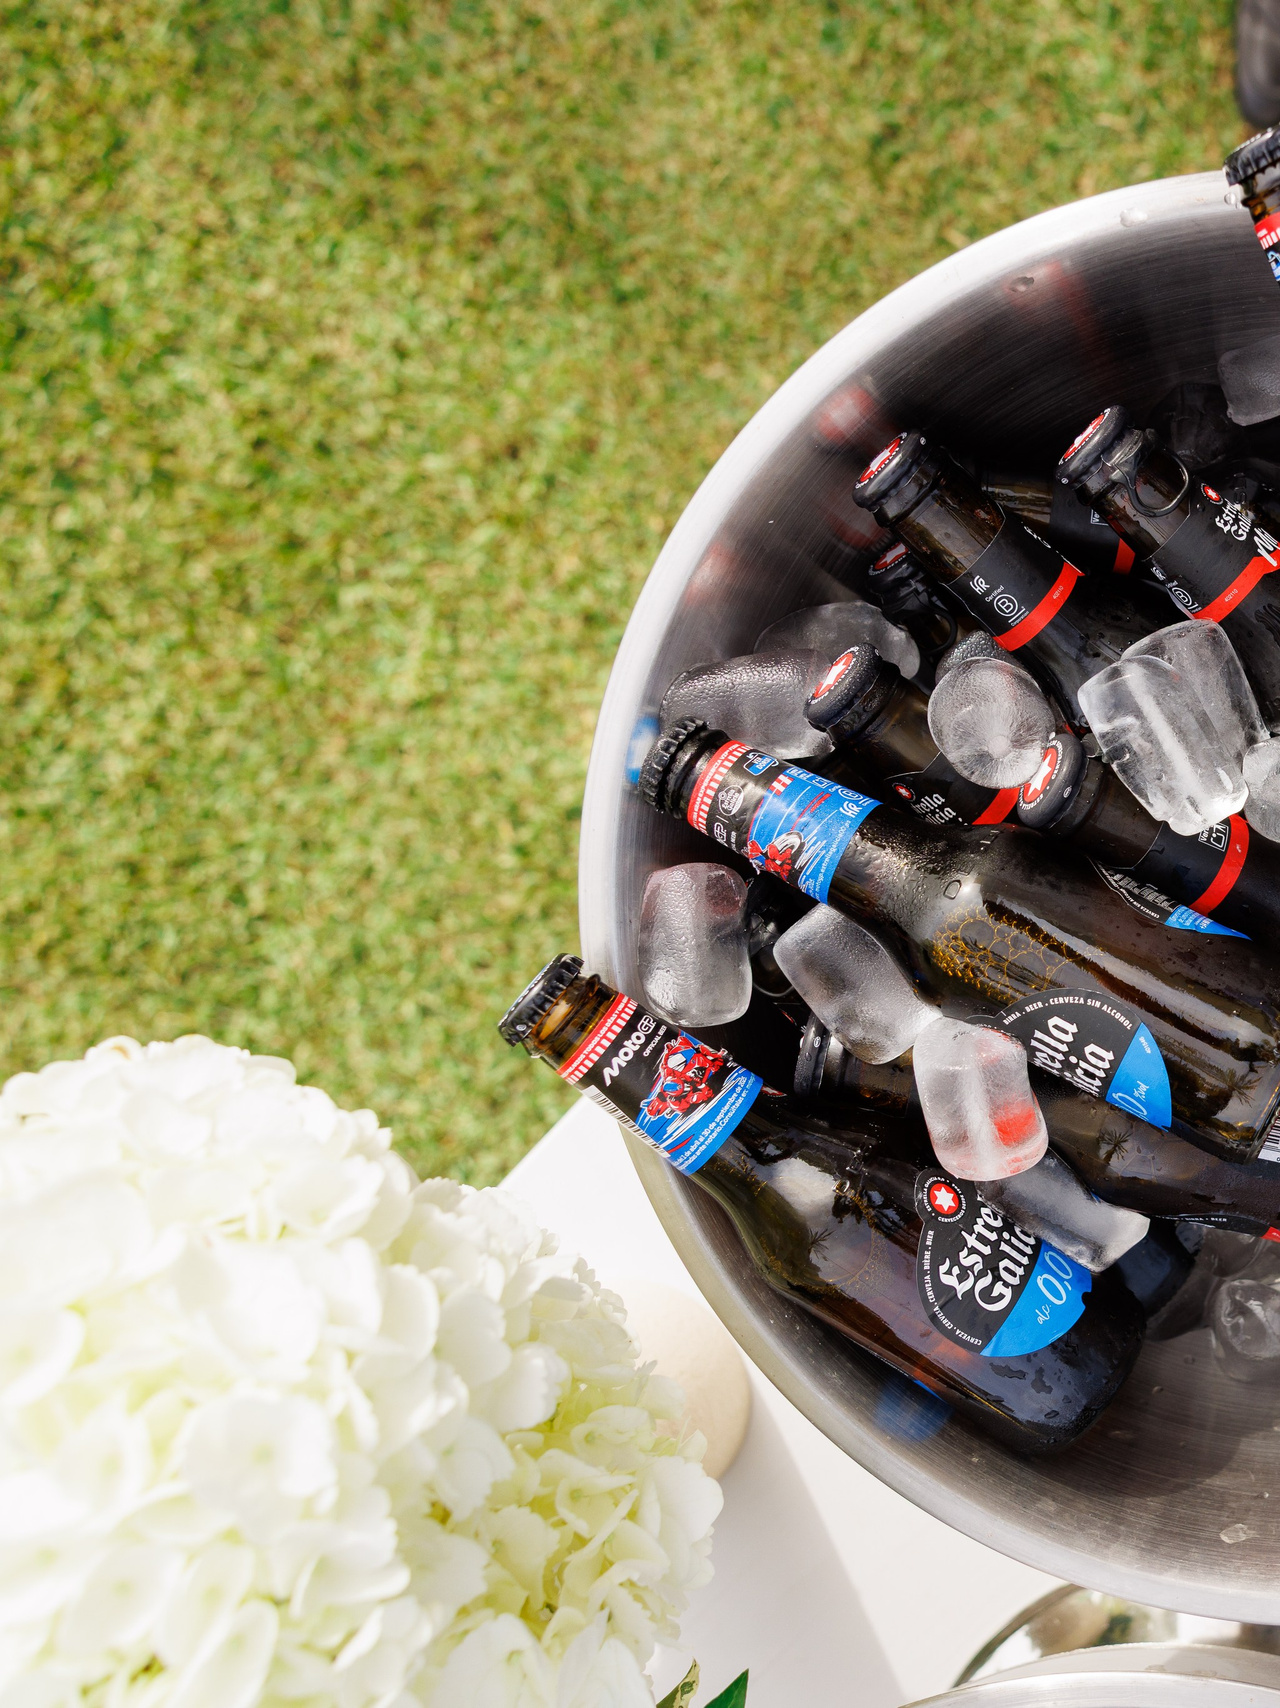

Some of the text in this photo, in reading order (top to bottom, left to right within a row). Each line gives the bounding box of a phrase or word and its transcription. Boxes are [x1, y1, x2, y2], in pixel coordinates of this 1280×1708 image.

[984, 584, 1004, 603] Certified
[1224, 588, 1238, 602] 402110
[838, 798, 862, 819] HR
[1003, 1011, 1020, 1024] BIRRA
[1025, 1003, 1043, 1011] BEER
[1087, 999, 1098, 1009] SIN
[1102, 1003, 1133, 1029] ALCOHOL
[582, 1035, 600, 1055] TODOS
[596, 1024, 608, 1037] LOS
[603, 1011, 618, 1027] DÍAS
[641, 1024, 667, 1057] OFFICIAL BEER
[595, 1014, 657, 1087] MotoGP
[686, 1138, 700, 1152] abril
[712, 1091, 737, 1124] septiembre
[693, 1142, 706, 1155] ante
[702, 1122, 722, 1146] notario.
[717, 1095, 741, 1126] Consúltalas
[926, 1229, 934, 1245] BIER
[925, 1275, 934, 1301] CERVEJA
[1033, 1248, 1073, 1307] 0,0
[932, 1305, 953, 1329] CERVEXA
[953, 1327, 982, 1346] CERVEZA
